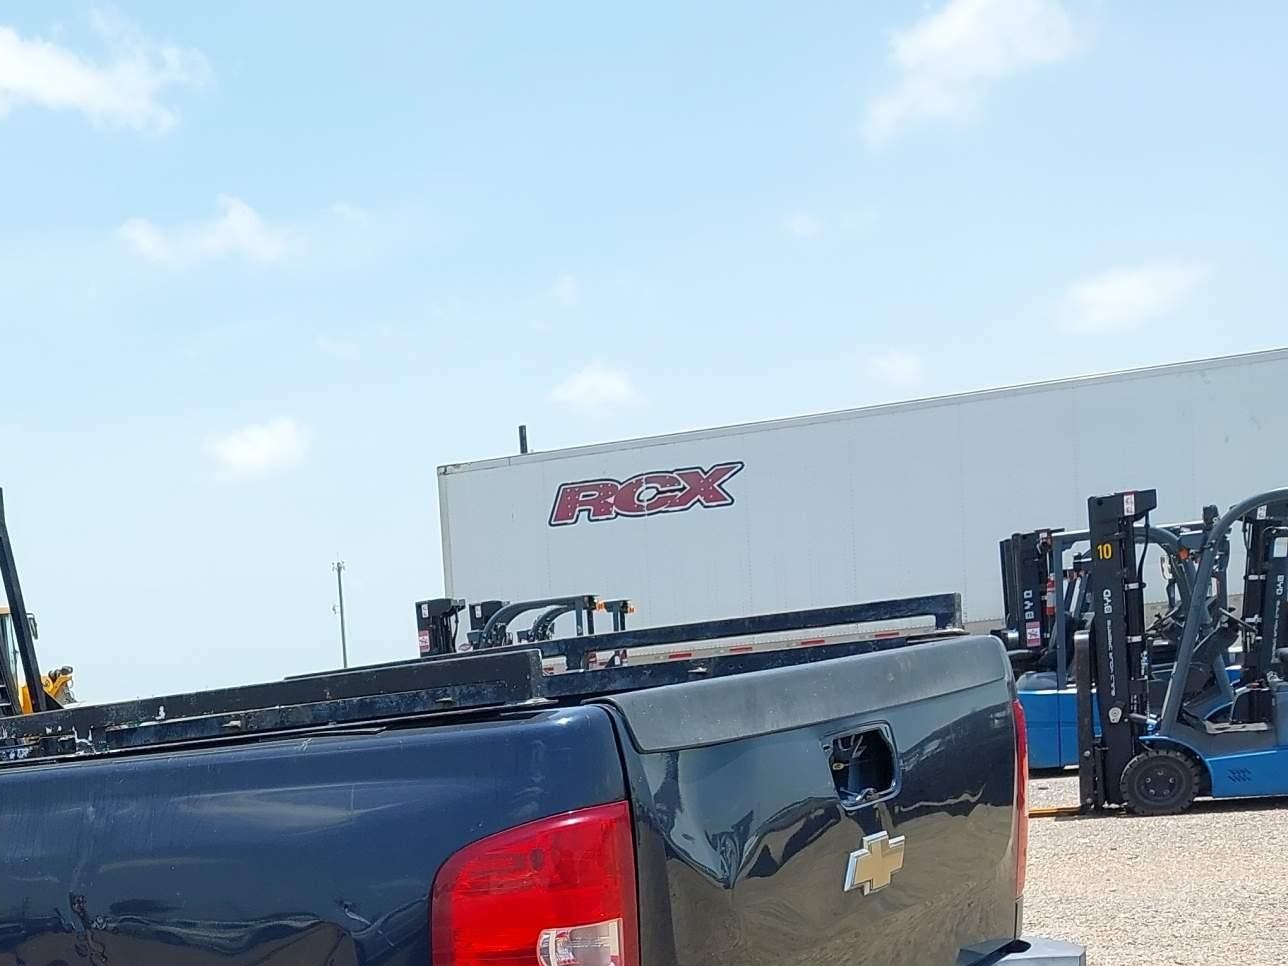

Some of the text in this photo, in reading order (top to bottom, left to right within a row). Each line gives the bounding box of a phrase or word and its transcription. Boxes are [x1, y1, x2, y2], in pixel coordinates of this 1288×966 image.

[549, 461, 745, 527] RCX
[1097, 543, 1112, 559] 10
[1023, 590, 1034, 619] BYD
[1103, 588, 1112, 613] BYD
